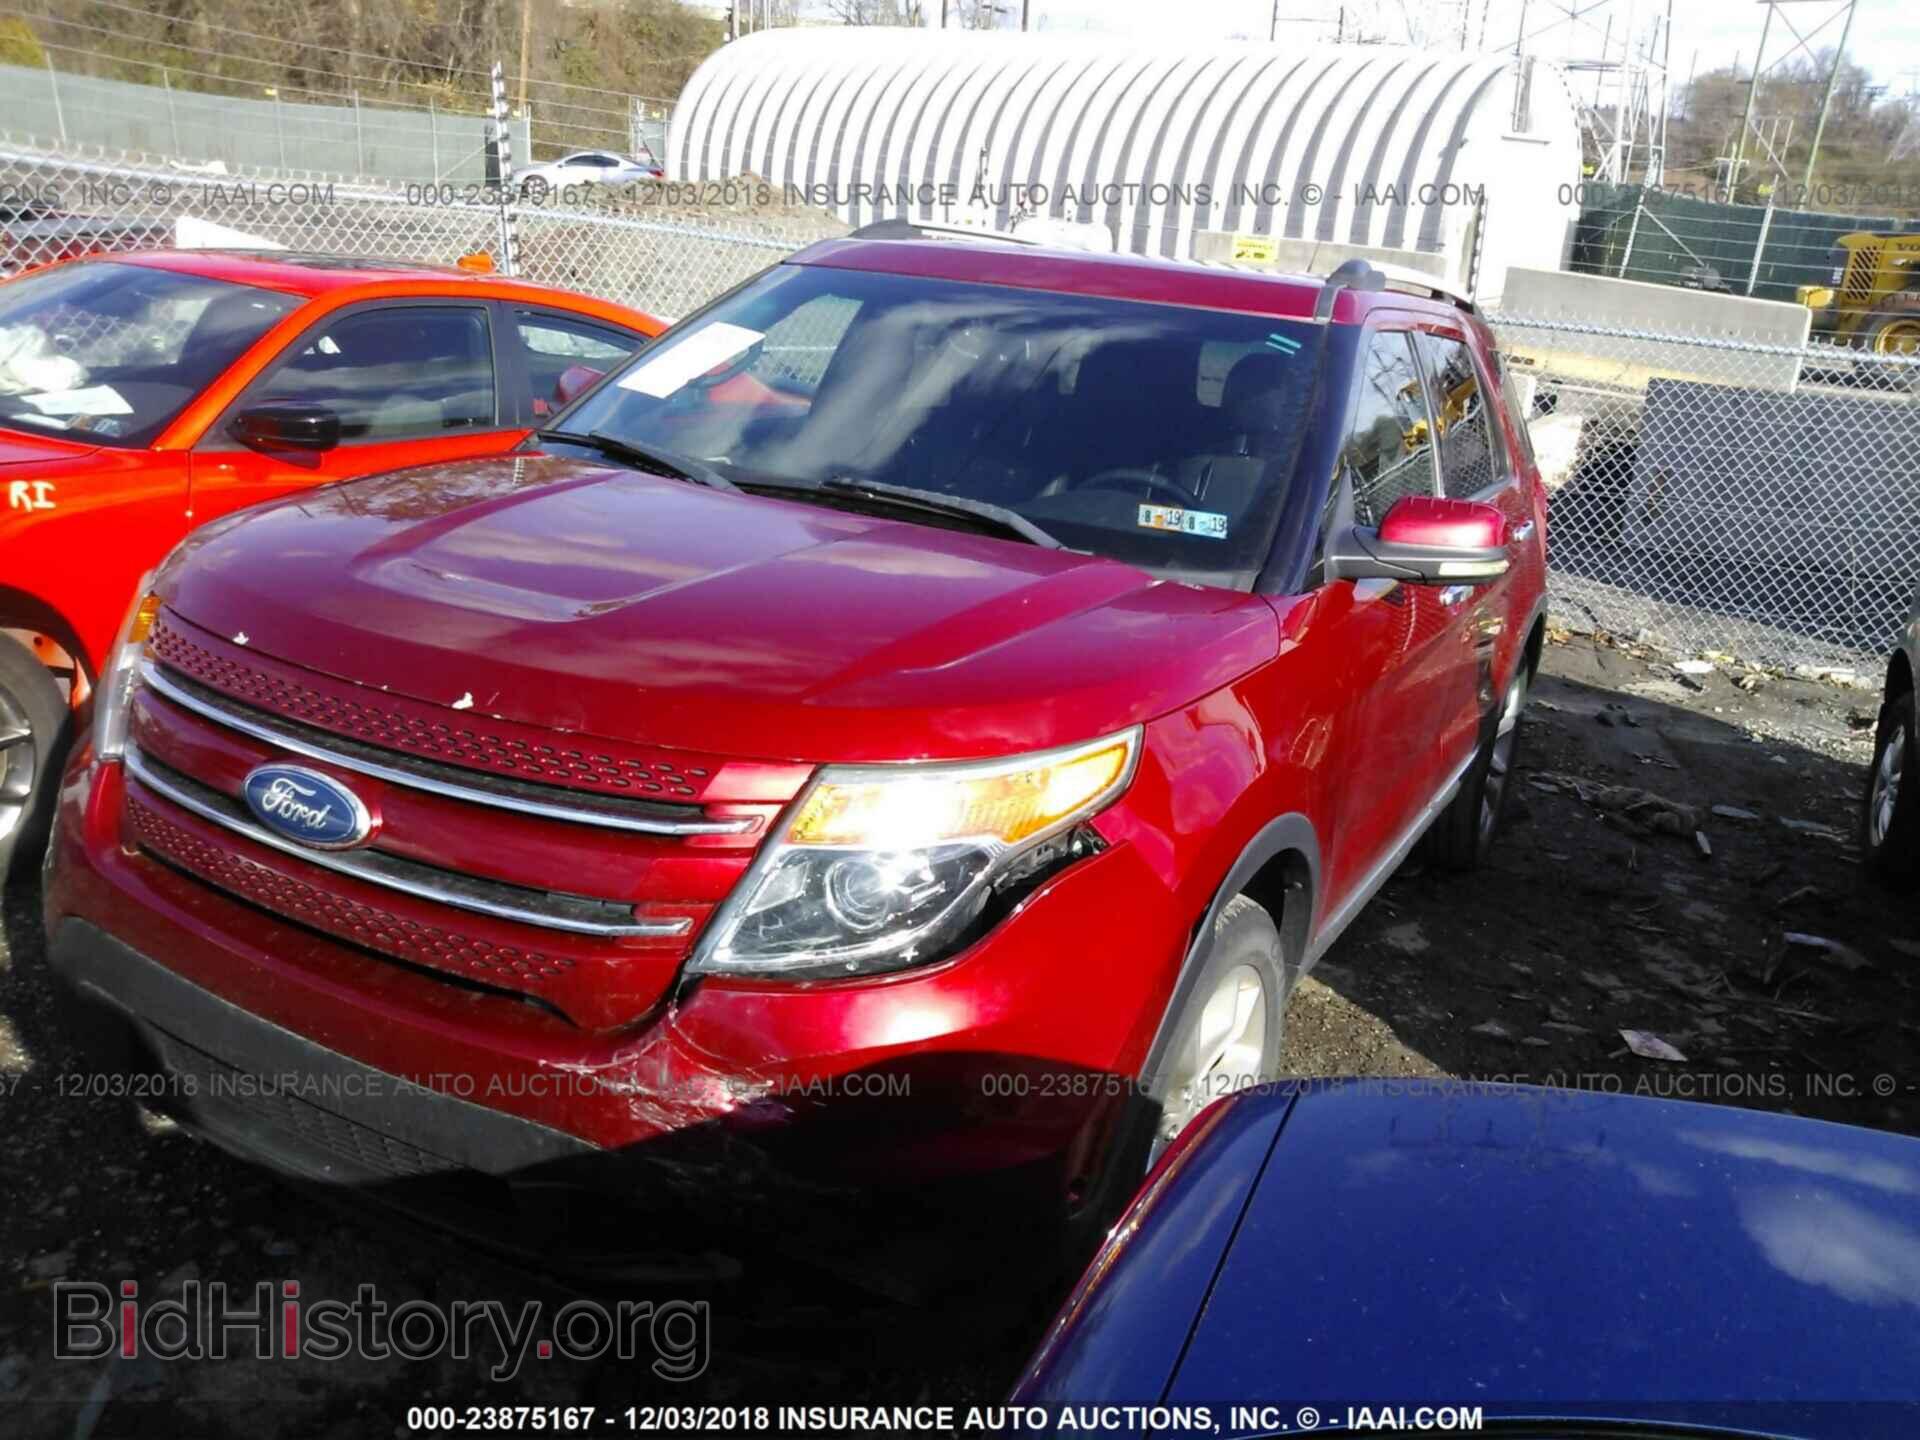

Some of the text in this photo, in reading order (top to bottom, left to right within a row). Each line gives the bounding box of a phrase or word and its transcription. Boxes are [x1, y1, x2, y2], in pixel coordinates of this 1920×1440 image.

[9, 480, 57, 512] RI
[1167, 509, 1182, 526] 19
[1209, 516, 1226, 533] 19
[262, 777, 332, 829] Ford
